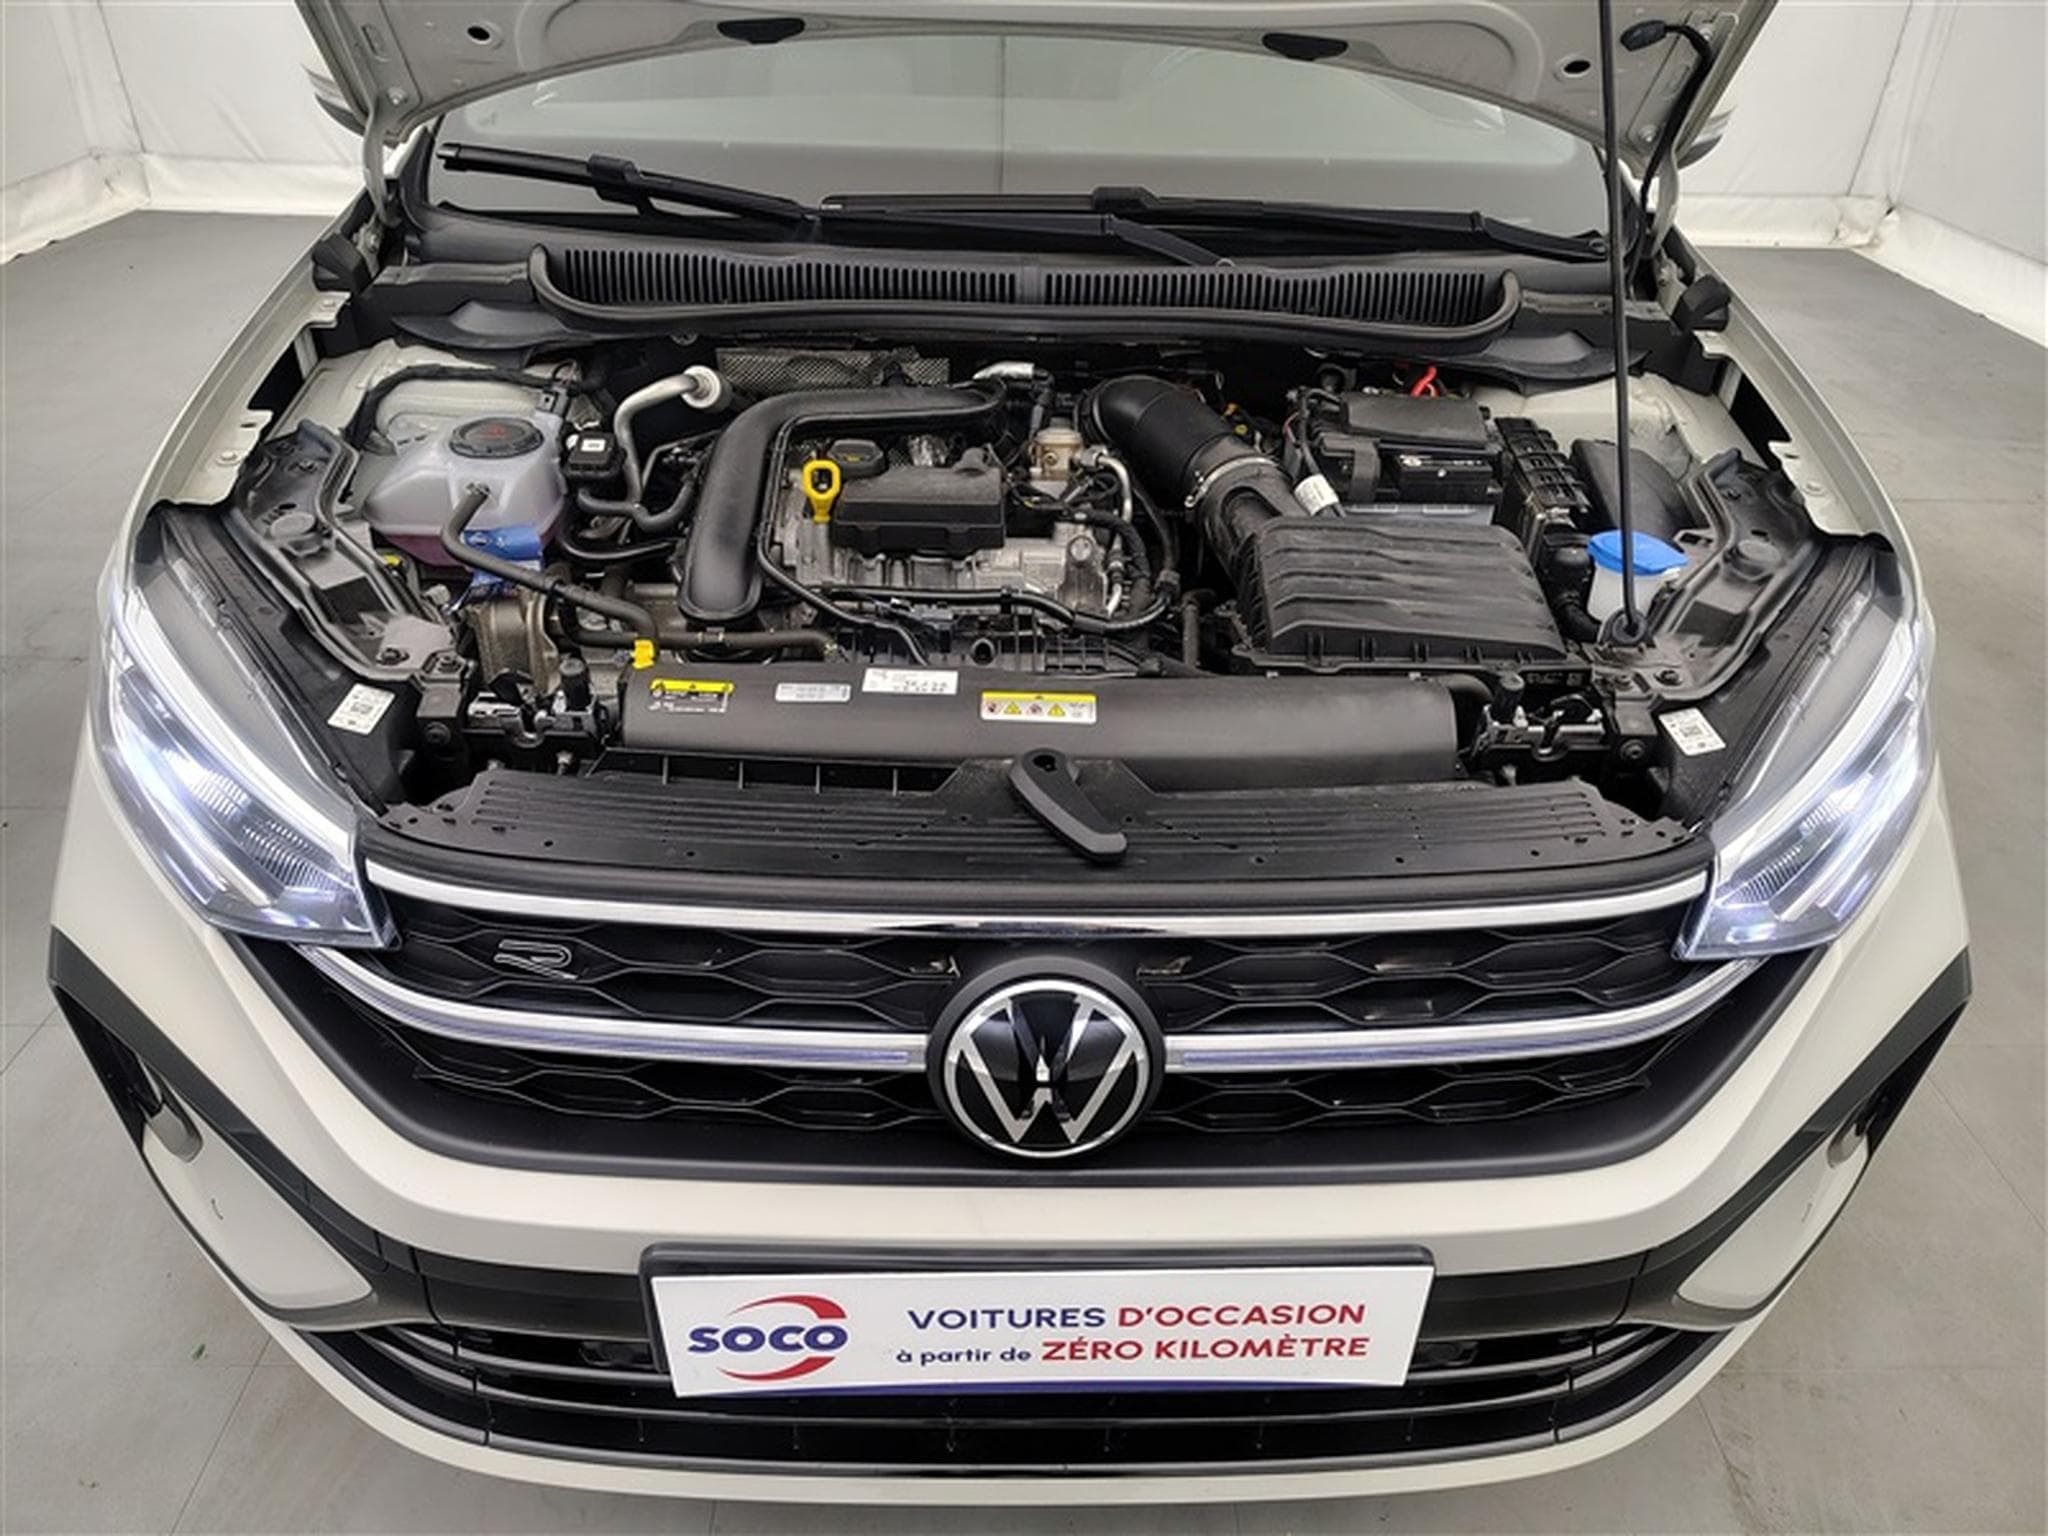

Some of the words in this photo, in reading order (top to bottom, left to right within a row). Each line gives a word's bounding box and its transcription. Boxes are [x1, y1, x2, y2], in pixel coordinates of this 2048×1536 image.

[907, 1307, 1106, 1330] VOITURES
[1118, 1303, 1366, 1328] D'OCCASION
[688, 1325, 849, 1354] SOCO
[896, 1349, 912, 1363] à
[920, 1348, 992, 1366] partir
[1000, 1347, 1032, 1361] de
[1041, 1336, 1143, 1361] ZÉRO
[1154, 1334, 1371, 1360] KILOMÈTRE
